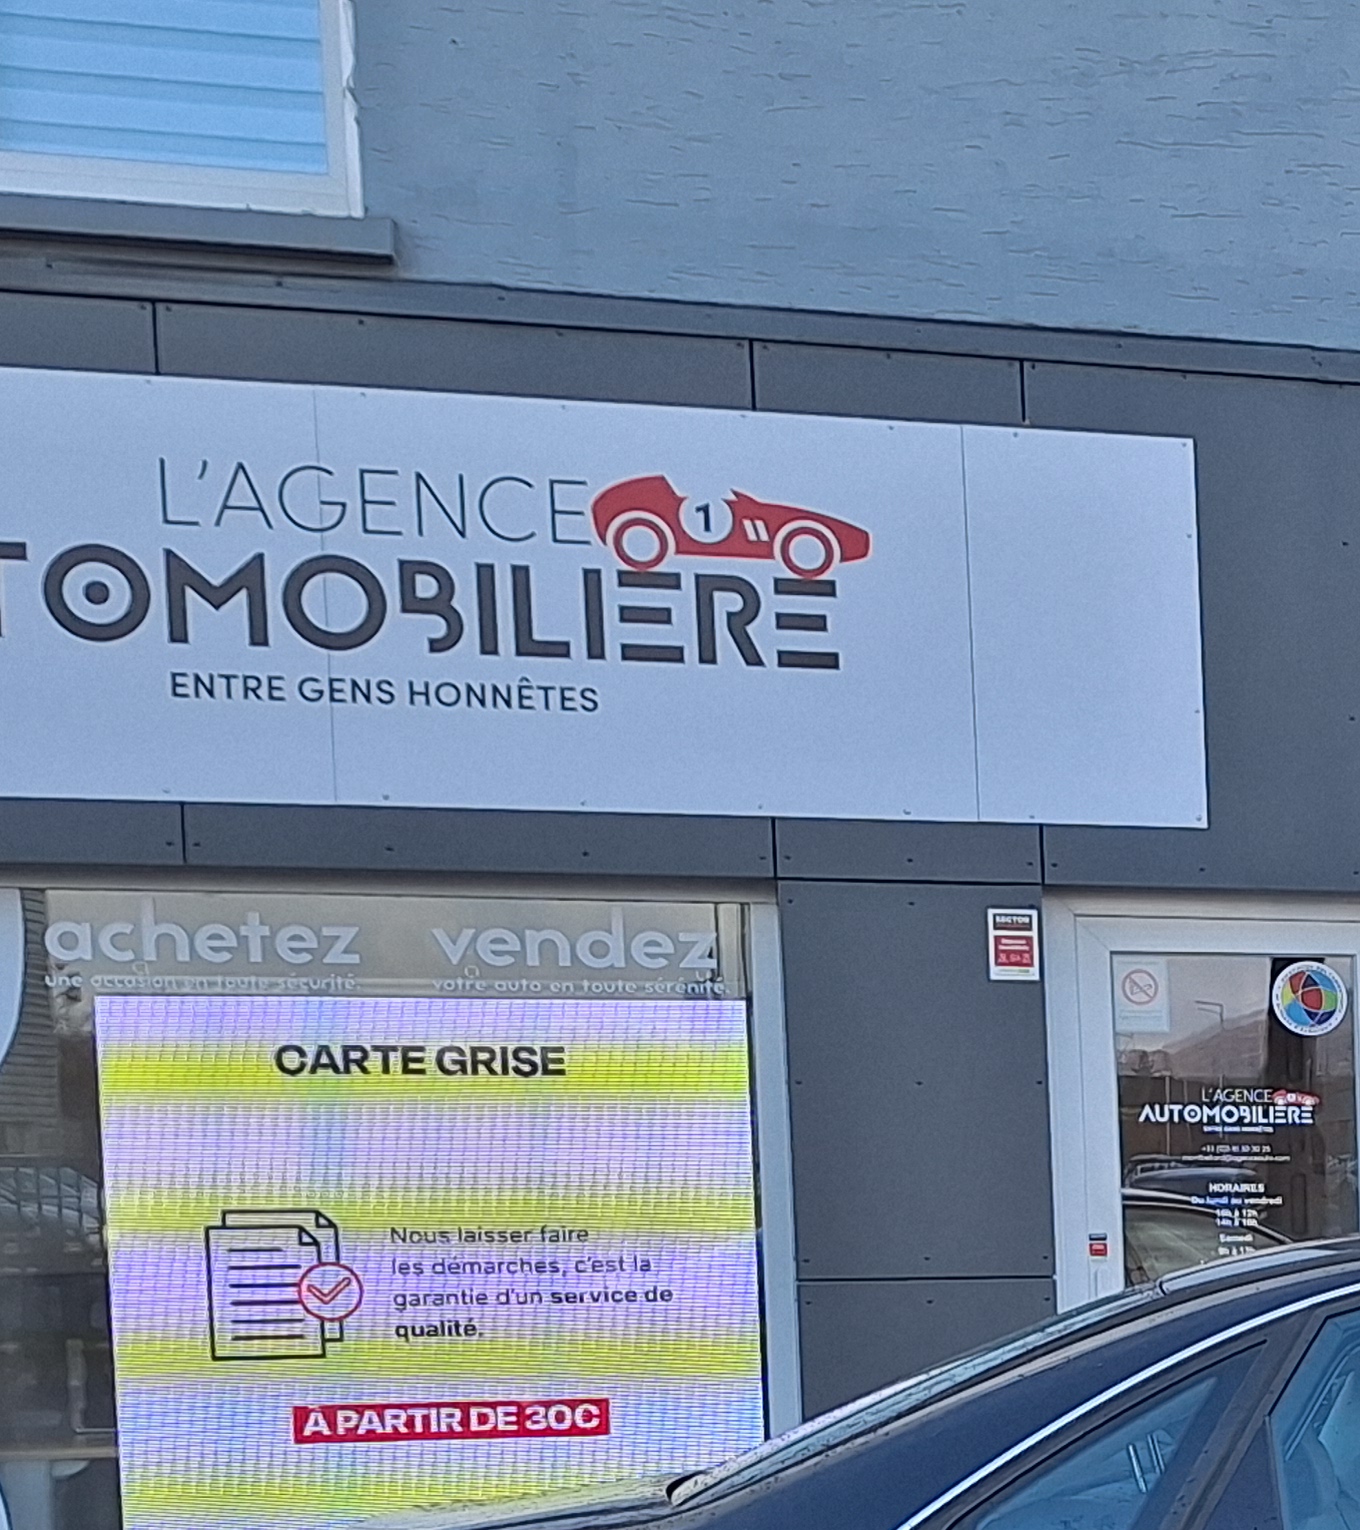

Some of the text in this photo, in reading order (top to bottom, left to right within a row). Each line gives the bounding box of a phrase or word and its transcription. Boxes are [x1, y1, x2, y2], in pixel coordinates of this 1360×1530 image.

[158, 457, 592, 546] L'AGENCE
[170, 671, 600, 713] ENTRE GENS HONNÊTES
[44, 898, 718, 970] achetez vendez
[45, 975, 84, 988] une
[432, 976, 486, 992] votre
[494, 977, 541, 992] auto
[551, 979, 575, 993] en
[583, 978, 637, 993] toute
[275, 1044, 567, 1077] CARTE GRISE
[1201, 1088, 1273, 1103] L'AGENCE
[390, 1225, 590, 1243] Nous laisser faire
[391, 1255, 651, 1277] les démarches, c'est la
[393, 1284, 674, 1312] garantie d'un service de
[395, 1317, 484, 1342] qualité.
[336, 1406, 462, 1436] PARTIR
[469, 1405, 519, 1432] DE
